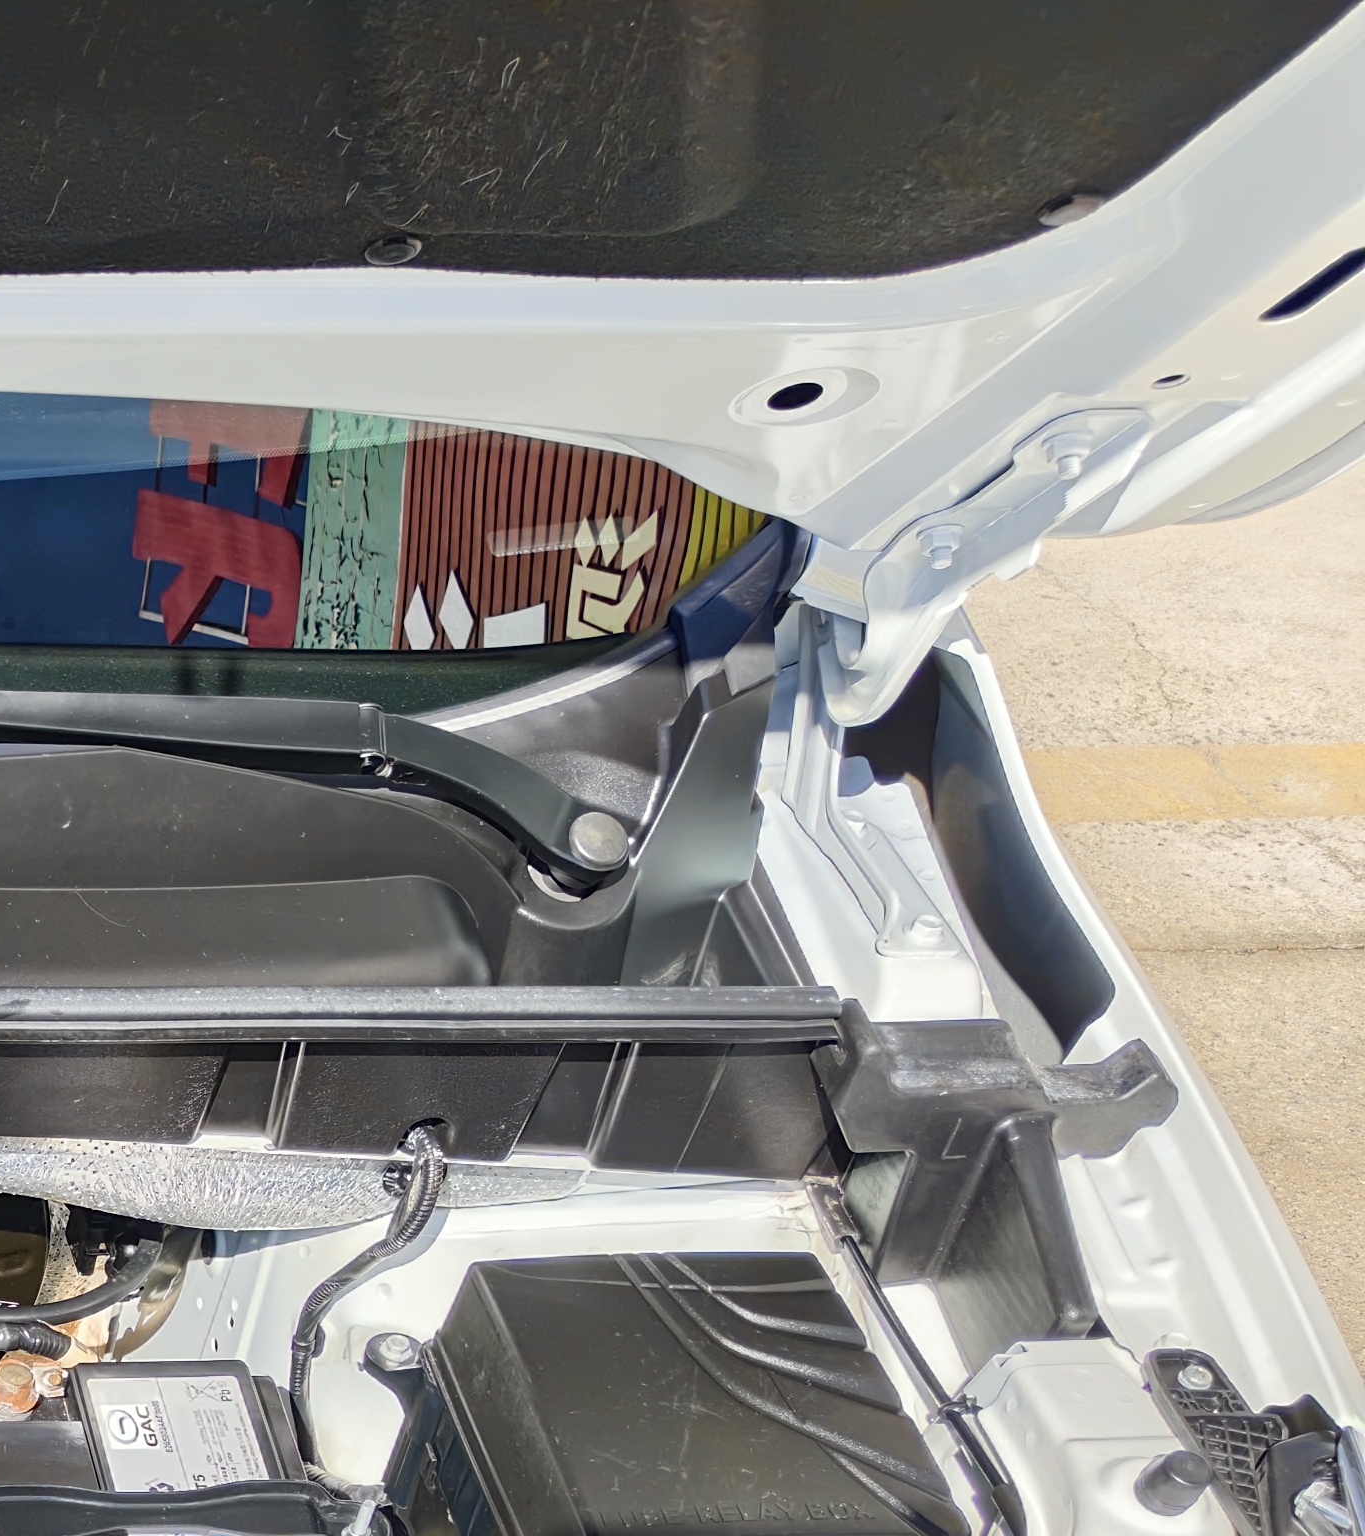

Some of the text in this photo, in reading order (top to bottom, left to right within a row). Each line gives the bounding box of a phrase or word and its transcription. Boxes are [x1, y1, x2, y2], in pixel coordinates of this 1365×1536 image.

[941, 1118, 966, 1159] L
[135, 1405, 158, 1447] GAC
[804, 1501, 876, 1521] BOX
